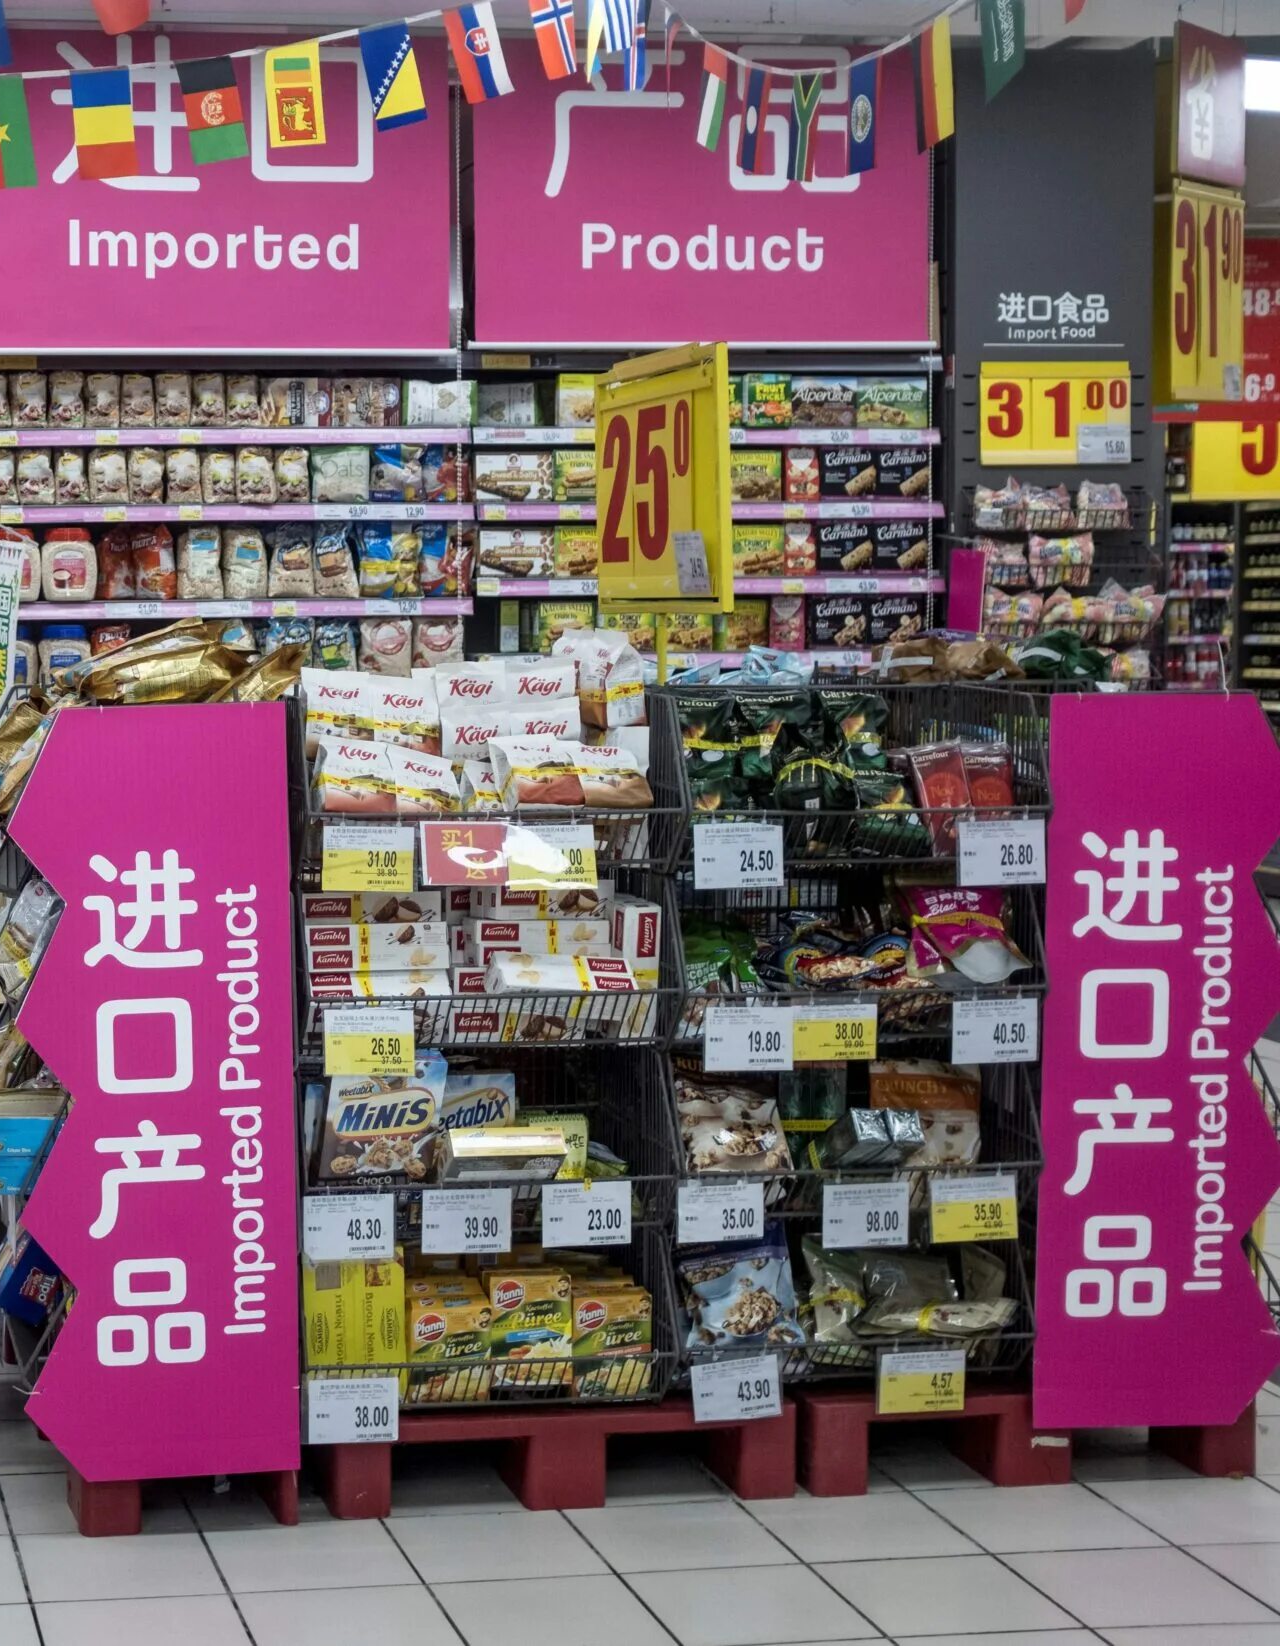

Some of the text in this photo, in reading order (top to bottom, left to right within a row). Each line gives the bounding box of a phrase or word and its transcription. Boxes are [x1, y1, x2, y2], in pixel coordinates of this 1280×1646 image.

[68, 220, 361, 280] Imported
[582, 222, 825, 273] Product
[997, 292, 1110, 324] 进口食品
[1008, 326, 1096, 342] Import Food
[792, 384, 830, 402] Alpen
[860, 384, 896, 402] Alpen
[322, 458, 365, 477] Oats
[825, 451, 872, 467] Carman's
[880, 451, 927, 466] Carman's
[349, 507, 368, 517] 49.90
[405, 507, 424, 517] 12.90
[821, 525, 868, 541] Carman's
[877, 525, 924, 540] Carman's
[398, 601, 417, 612] 12.90
[816, 602, 862, 616] Carman's
[449, 677, 494, 698] Kägi
[518, 676, 563, 697] Kägi
[383, 692, 424, 709] Kägi
[455, 724, 499, 745] Kägi
[525, 719, 568, 741] Kägi
[912, 750, 950, 763] Carrefour
[404, 759, 443, 778] Kägi
[367, 850, 397, 868] 31.00
[739, 849, 774, 872] 24.50
[1000, 843, 1034, 866] 26.80
[504, 889, 537, 903] Kambly
[309, 902, 348, 917] Kambly
[313, 930, 347, 945] Kambly
[484, 926, 516, 939] Kambly
[645, 916, 654, 953] Kambly
[315, 953, 350, 967] Kambly
[315, 972, 348, 986] Kambly
[835, 1022, 864, 1040] 38.00
[993, 1022, 1026, 1044] 40.50
[371, 1037, 401, 1056] 26.50
[748, 1030, 781, 1052] 19.80
[381, 1056, 402, 1065] 37.50
[1063, 827, 1183, 1319] 进口产品
[1183, 863, 1234, 1293] Imported Product
[338, 1084, 375, 1098] Weetabix
[82, 847, 208, 1368] 进口产品
[215, 883, 276, 1336] Imported Product
[439, 1095, 509, 1134] eetabix
[357, 1175, 392, 1187] CHOCO
[587, 1208, 622, 1231] 23.00
[721, 1207, 755, 1230] 35.00
[866, 1210, 899, 1232] 98.00
[974, 1203, 1002, 1221] 35.90
[346, 1218, 382, 1241] 48.30
[464, 1216, 498, 1239] 39.90
[494, 1285, 524, 1303] Pfanni
[510, 1310, 563, 1330] Püree
[576, 1306, 606, 1324] Pfanni
[316, 1312, 324, 1354] SGAMBARO
[364, 1292, 374, 1363] BIGOLI NOBIL
[385, 1307, 394, 1350] SGAMBARO
[415, 1320, 446, 1336] Pfanni
[591, 1328, 643, 1347] Püree
[431, 1339, 483, 1358] Püree
[737, 1378, 770, 1401] 43.90
[931, 1372, 953, 1389] 4.57
[355, 1405, 389, 1428] 38.00
